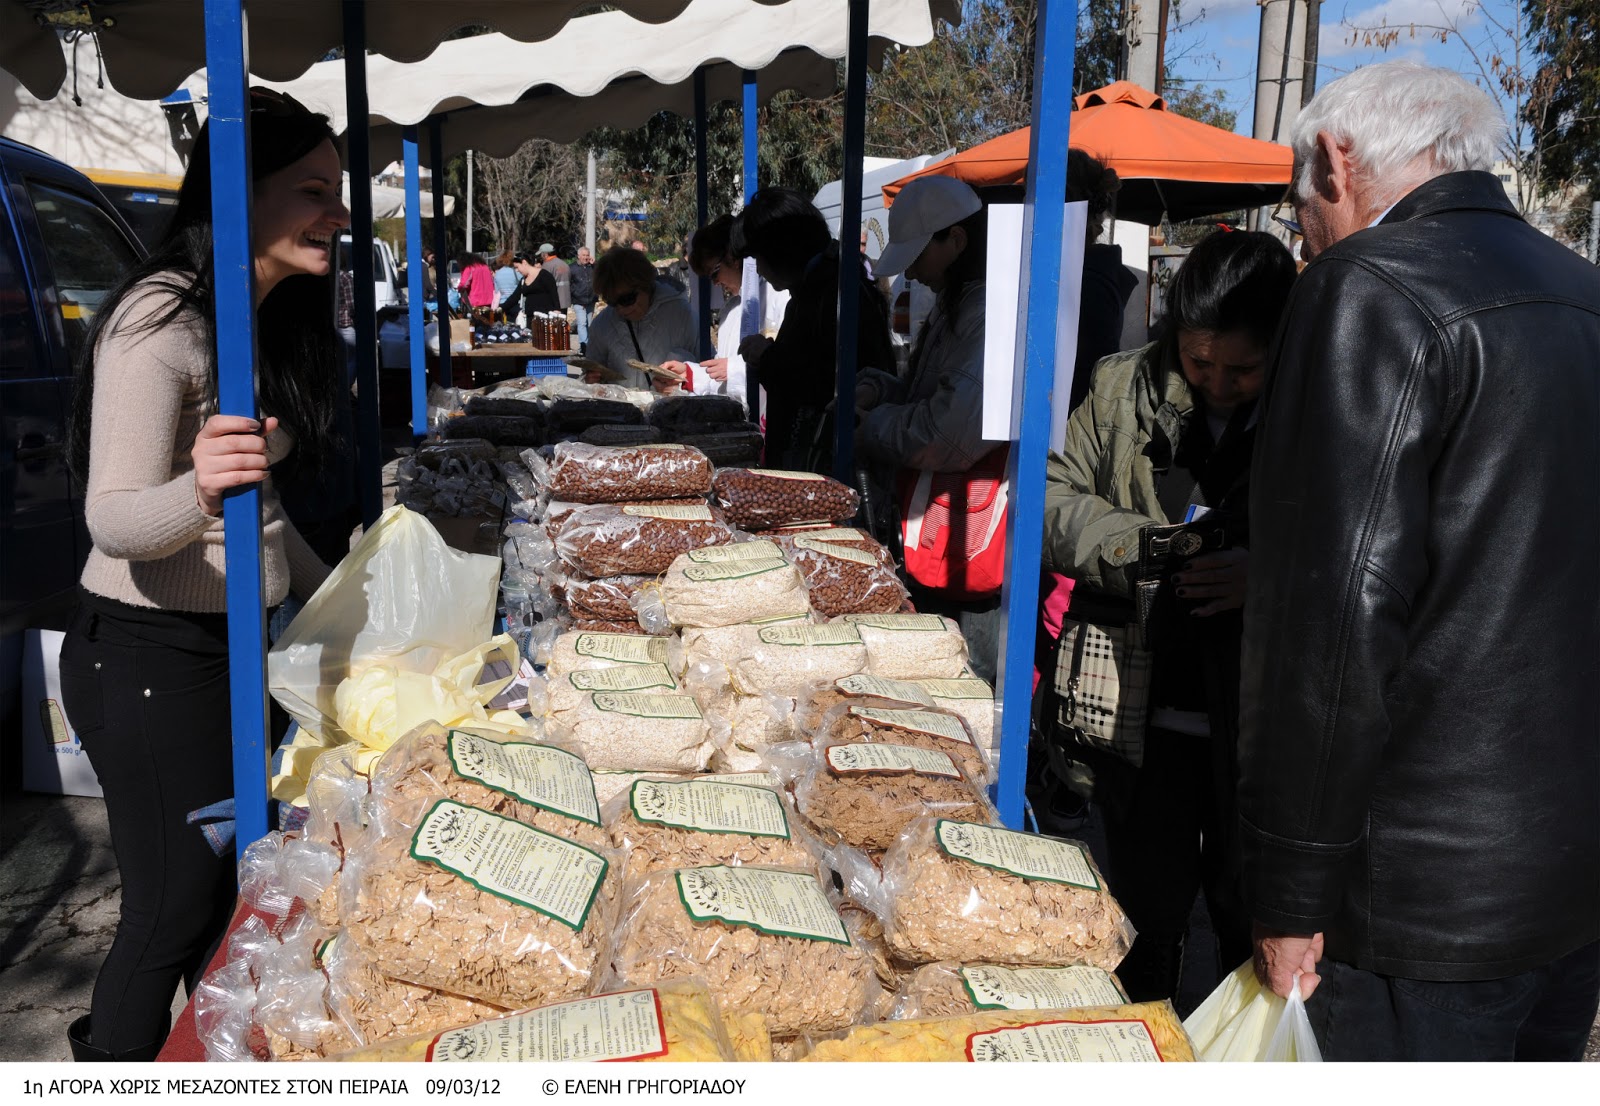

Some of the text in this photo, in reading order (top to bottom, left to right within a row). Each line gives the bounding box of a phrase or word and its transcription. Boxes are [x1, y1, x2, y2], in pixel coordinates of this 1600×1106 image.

[427, 808, 465, 855] ΠΑΡΑΔΟΣΙΑΚΑ
[464, 820, 492, 862] Fit flakes
